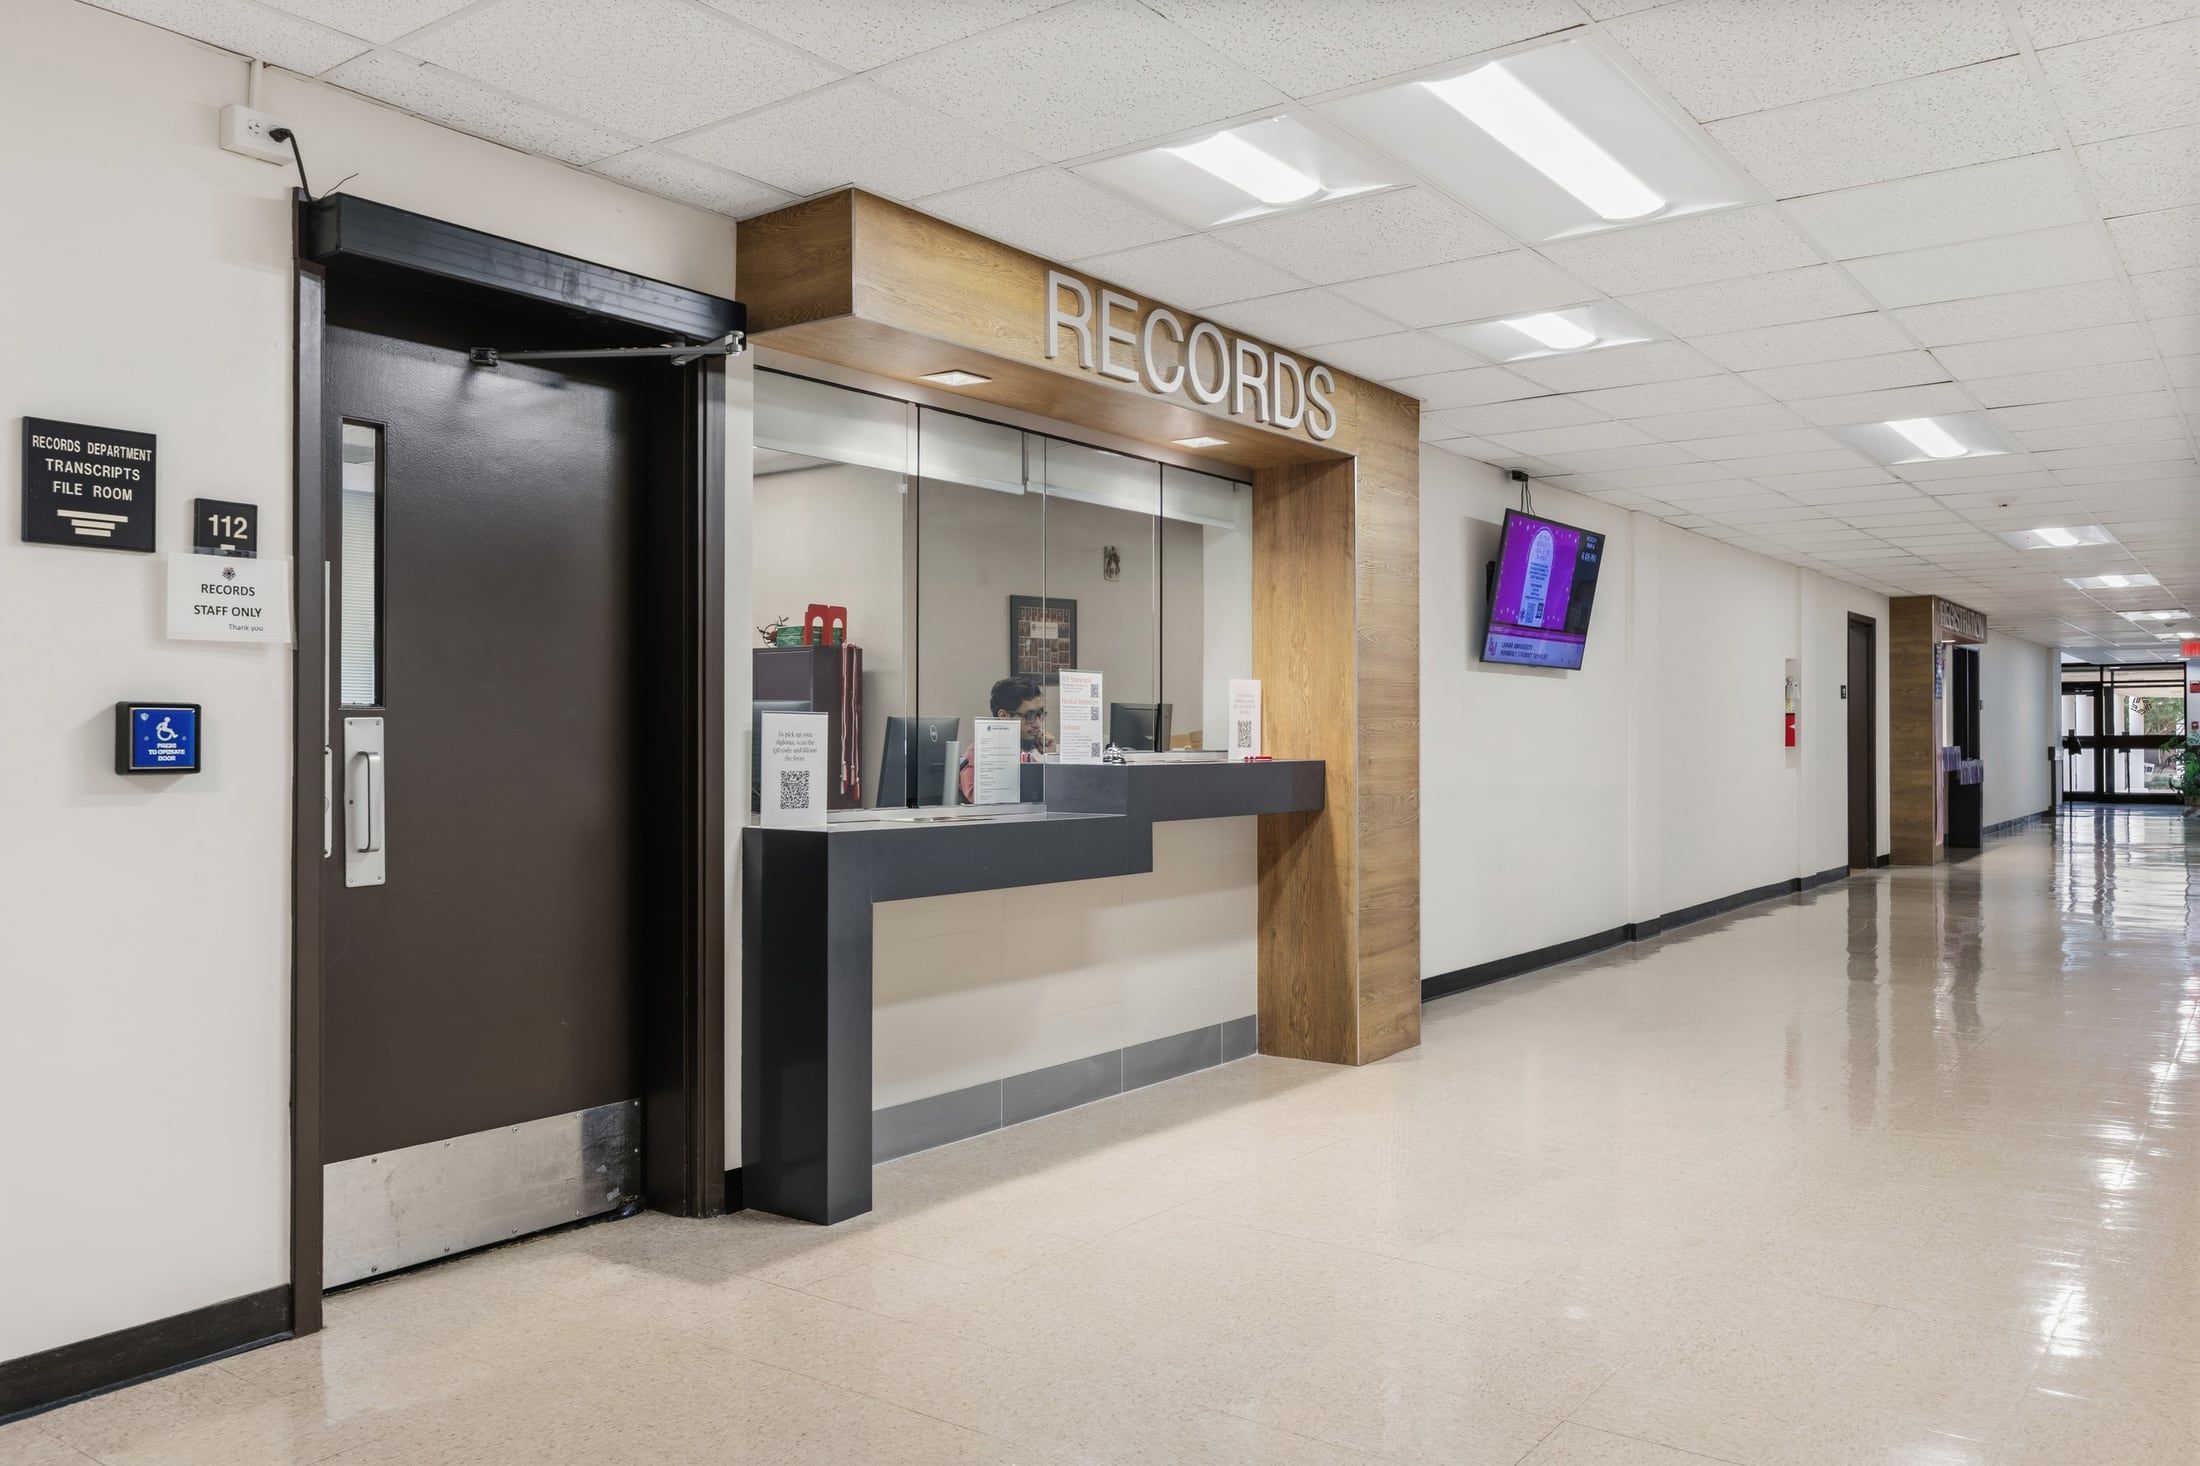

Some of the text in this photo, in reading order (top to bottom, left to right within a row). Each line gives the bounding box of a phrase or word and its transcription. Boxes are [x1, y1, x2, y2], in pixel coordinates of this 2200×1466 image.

[1045, 270, 1337, 441] RECORDS
[32, 435, 153, 462] RECORDS DEPARTMENT
[45, 458, 141, 481] TRANSCRIPTS
[53, 481, 133, 501] FILE ROOM
[208, 514, 248, 539] 112
[201, 584, 256, 597] RECORDS
[194, 605, 262, 618] STAFF ONLY
[1940, 600, 1984, 639] REGISTRATION
[228, 623, 264, 633] Thank you
